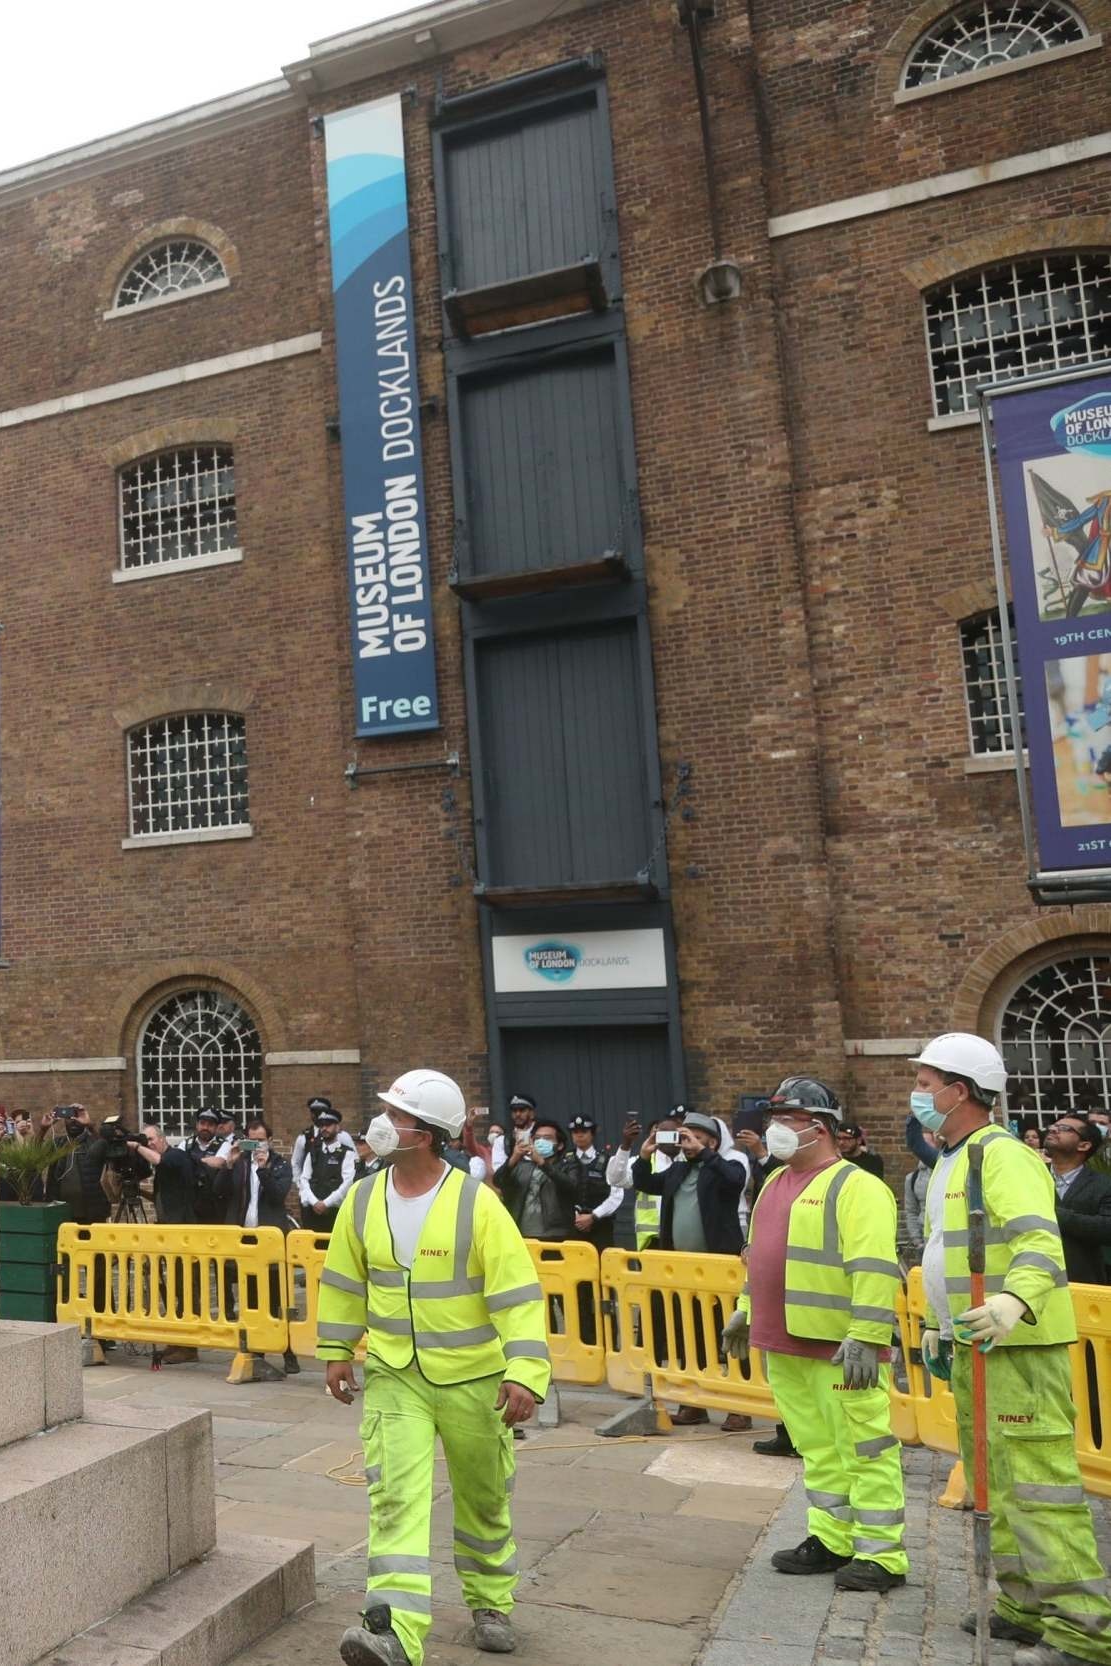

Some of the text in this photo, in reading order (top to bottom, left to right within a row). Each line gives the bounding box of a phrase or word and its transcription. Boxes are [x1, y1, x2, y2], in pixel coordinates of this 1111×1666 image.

[1066, 422, 1082, 435] OF
[1067, 430, 1111, 446] DOCKL
[373, 275, 427, 653] OF LONDON DOCKLANDS
[351, 511, 391, 659] MUSEUM
[1054, 631, 1084, 645] 19TH
[361, 695, 431, 723] Free
[1077, 839, 1106, 851] 21ST
[529, 950, 567, 961] MUSEUM
[529, 960, 539, 969] OF
[542, 958, 576, 969] LONDON
[420, 1249, 449, 1257] RINEY
[997, 1413, 1034, 1423] RINEY
